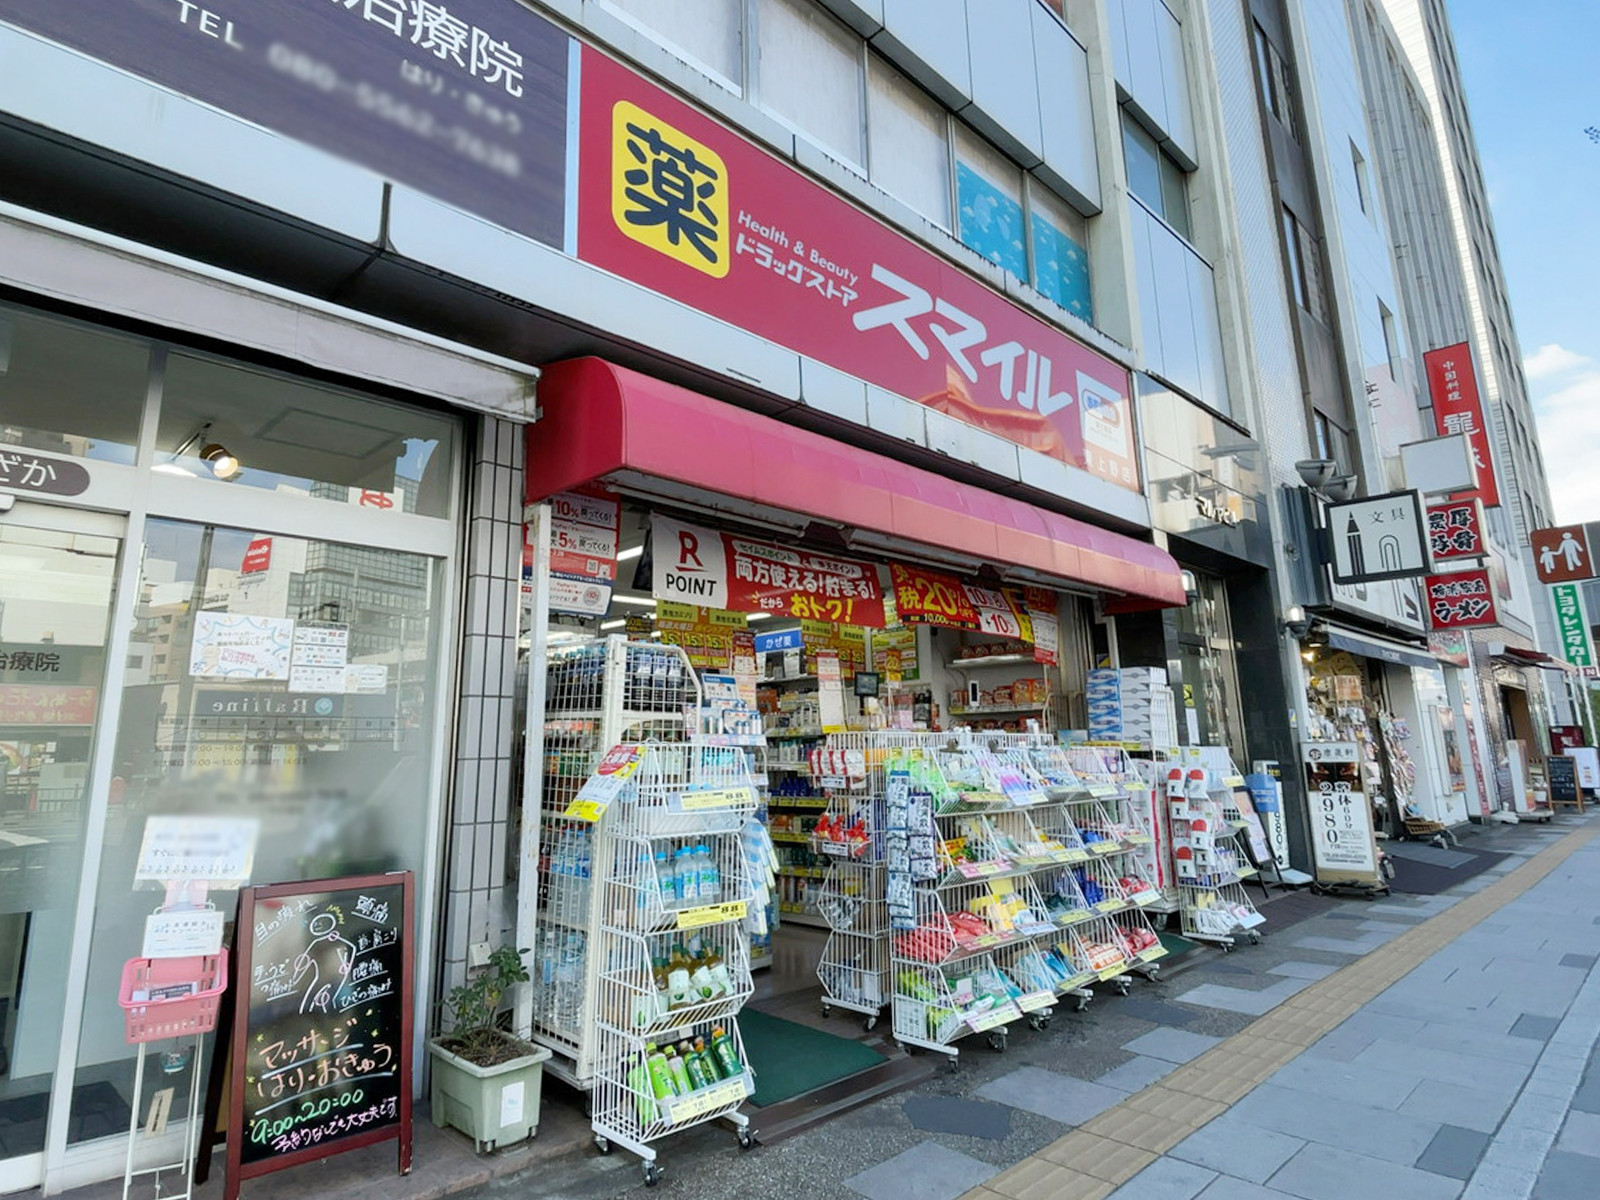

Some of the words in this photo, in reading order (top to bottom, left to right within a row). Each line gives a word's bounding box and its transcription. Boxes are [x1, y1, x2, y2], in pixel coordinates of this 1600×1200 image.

[176, 0, 244, 50] TEL
[624, 121, 719, 265] 薬
[737, 209, 789, 249] Health
[794, 240, 805, 257] &
[809, 248, 859, 286] Beauty
[735, 234, 859, 308] ドラッグストア
[851, 263, 1073, 418] スマイル
[1442, 360, 1463, 402] 中国料理
[1369, 505, 1406, 525] 文具
[666, 572, 718, 597] POINT
[759, 595, 785, 610] だから
[1433, 598, 1491, 623] ラーメン
[765, 637, 793, 650] かぜ薬
[354, 895, 389, 923] 頭痛
[259, 1017, 358, 1069] マッサージ
